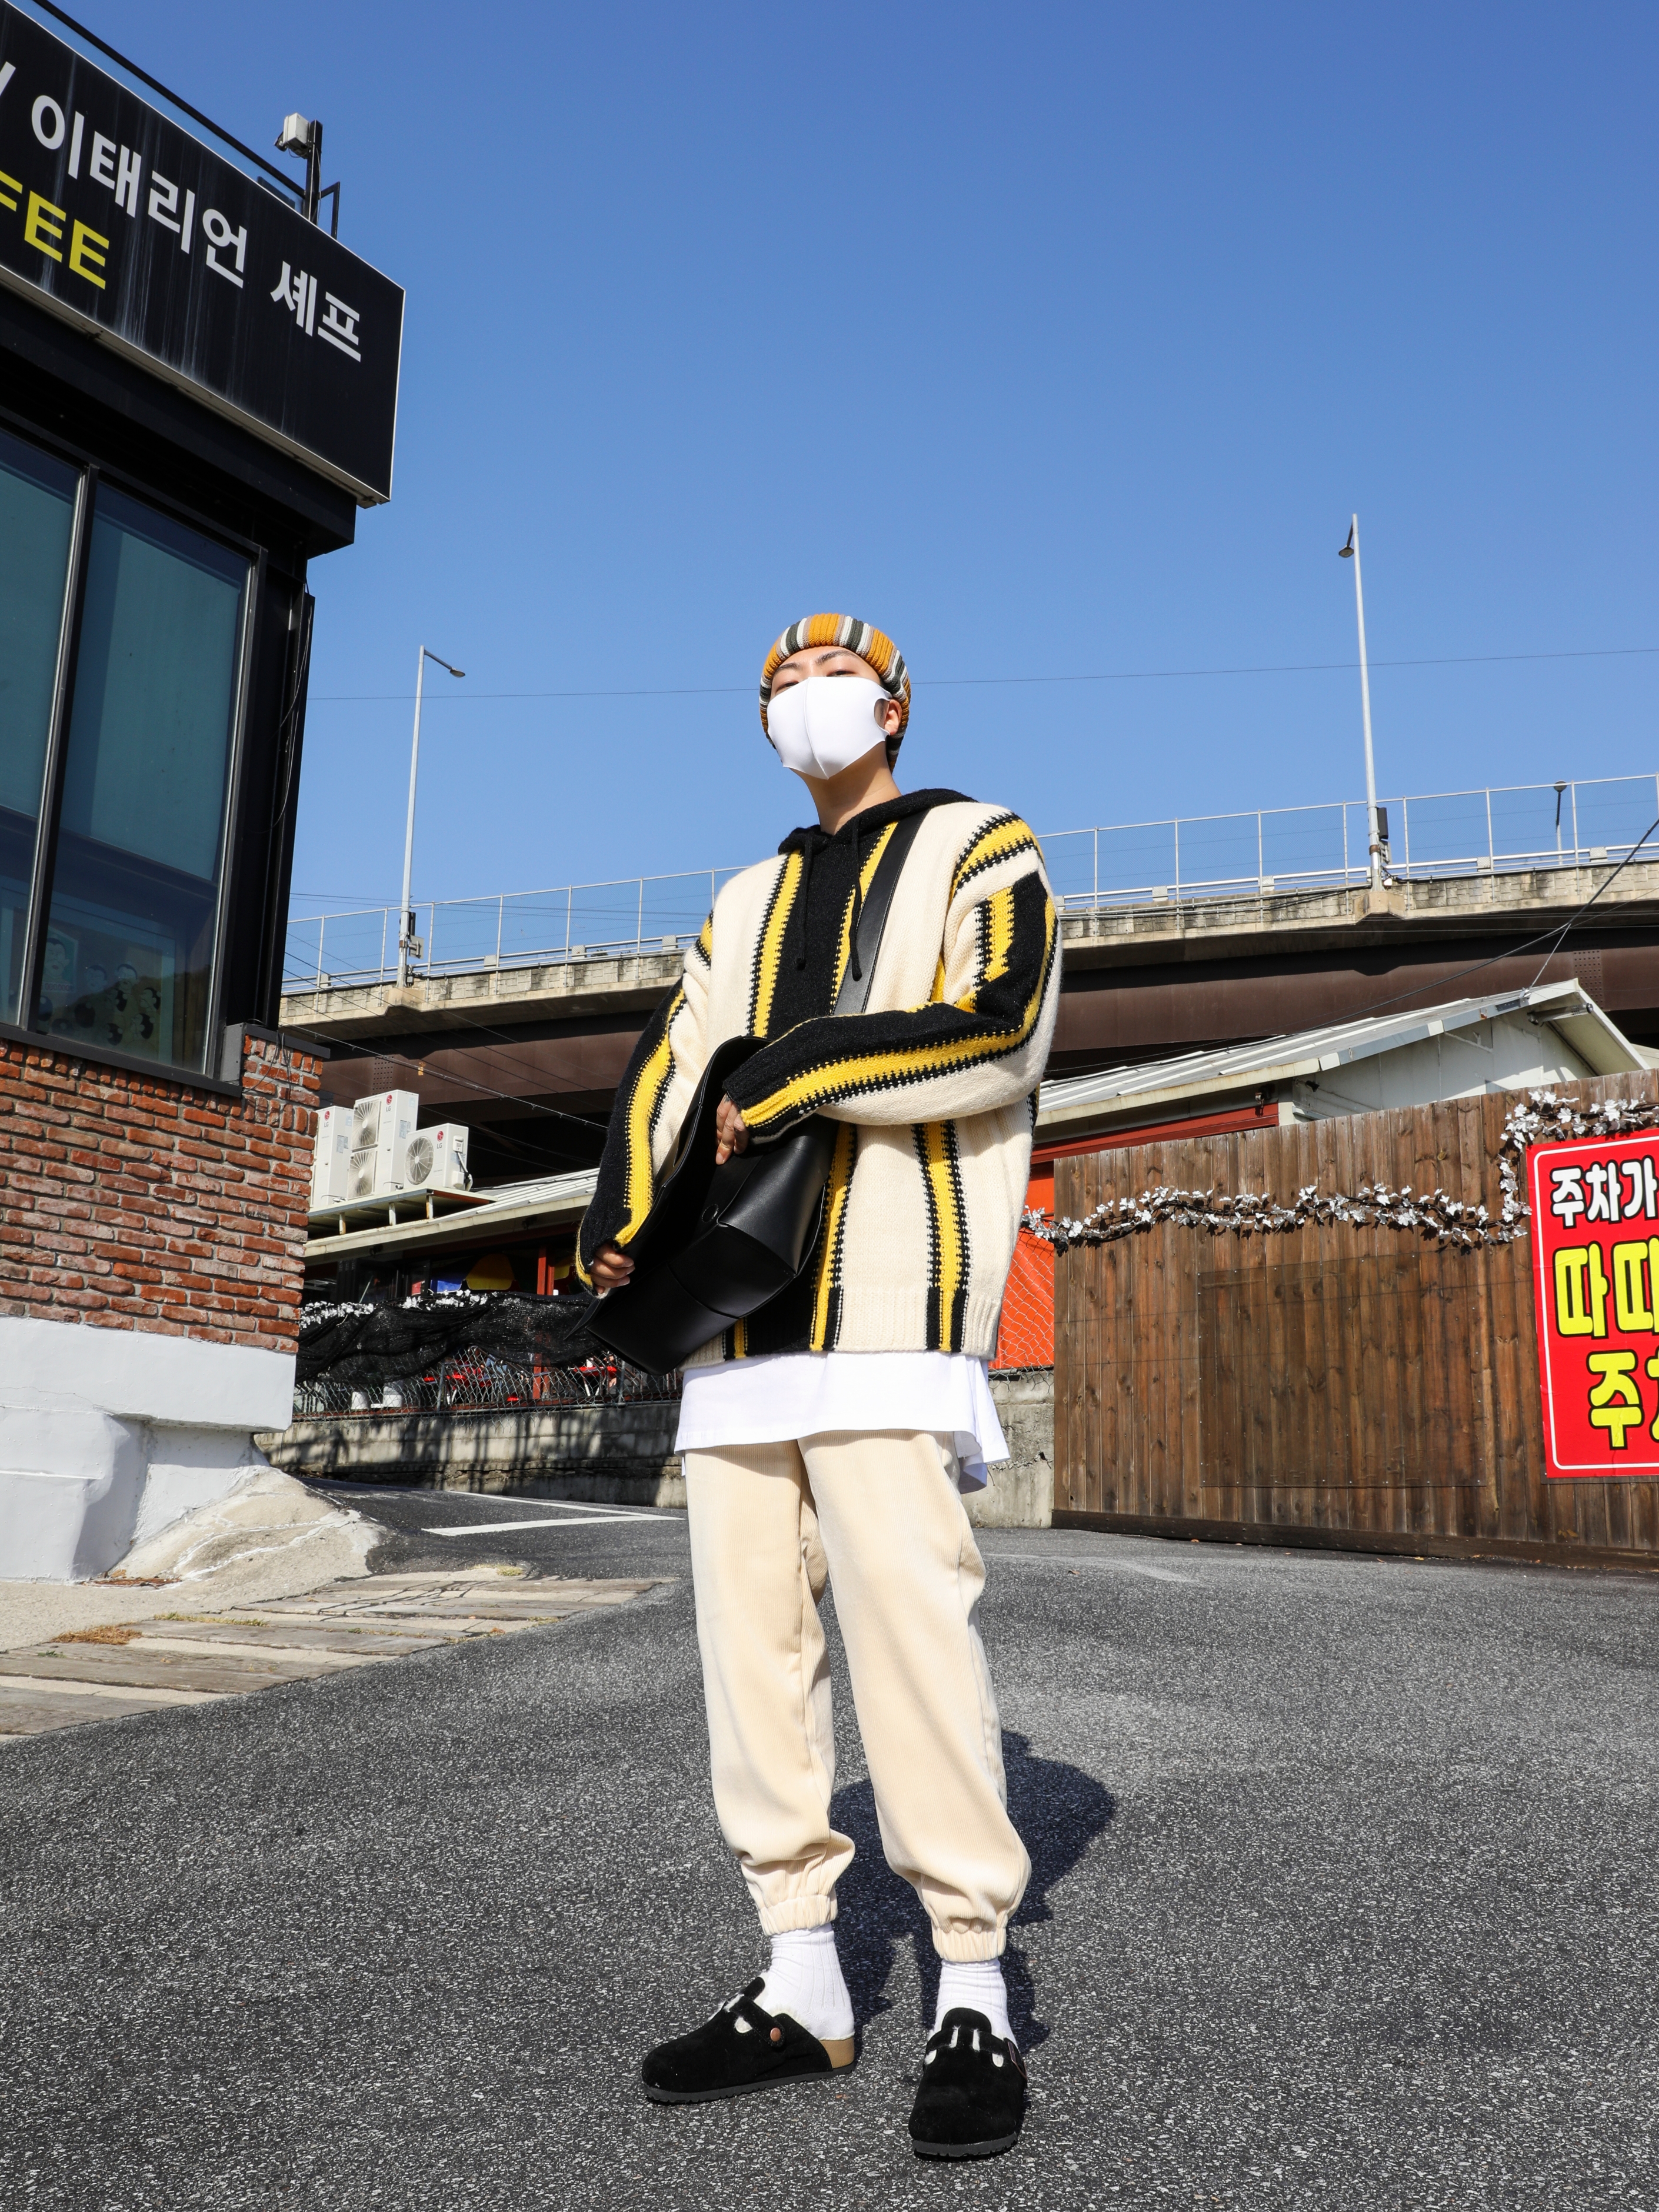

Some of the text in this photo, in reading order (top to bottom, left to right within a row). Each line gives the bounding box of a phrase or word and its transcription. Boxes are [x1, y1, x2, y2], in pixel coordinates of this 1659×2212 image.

[31, 95, 361, 362] 이태리언 셰프
[1551, 1157, 1659, 1228] 주차가
[1588, 1347, 1659, 1449] 주
